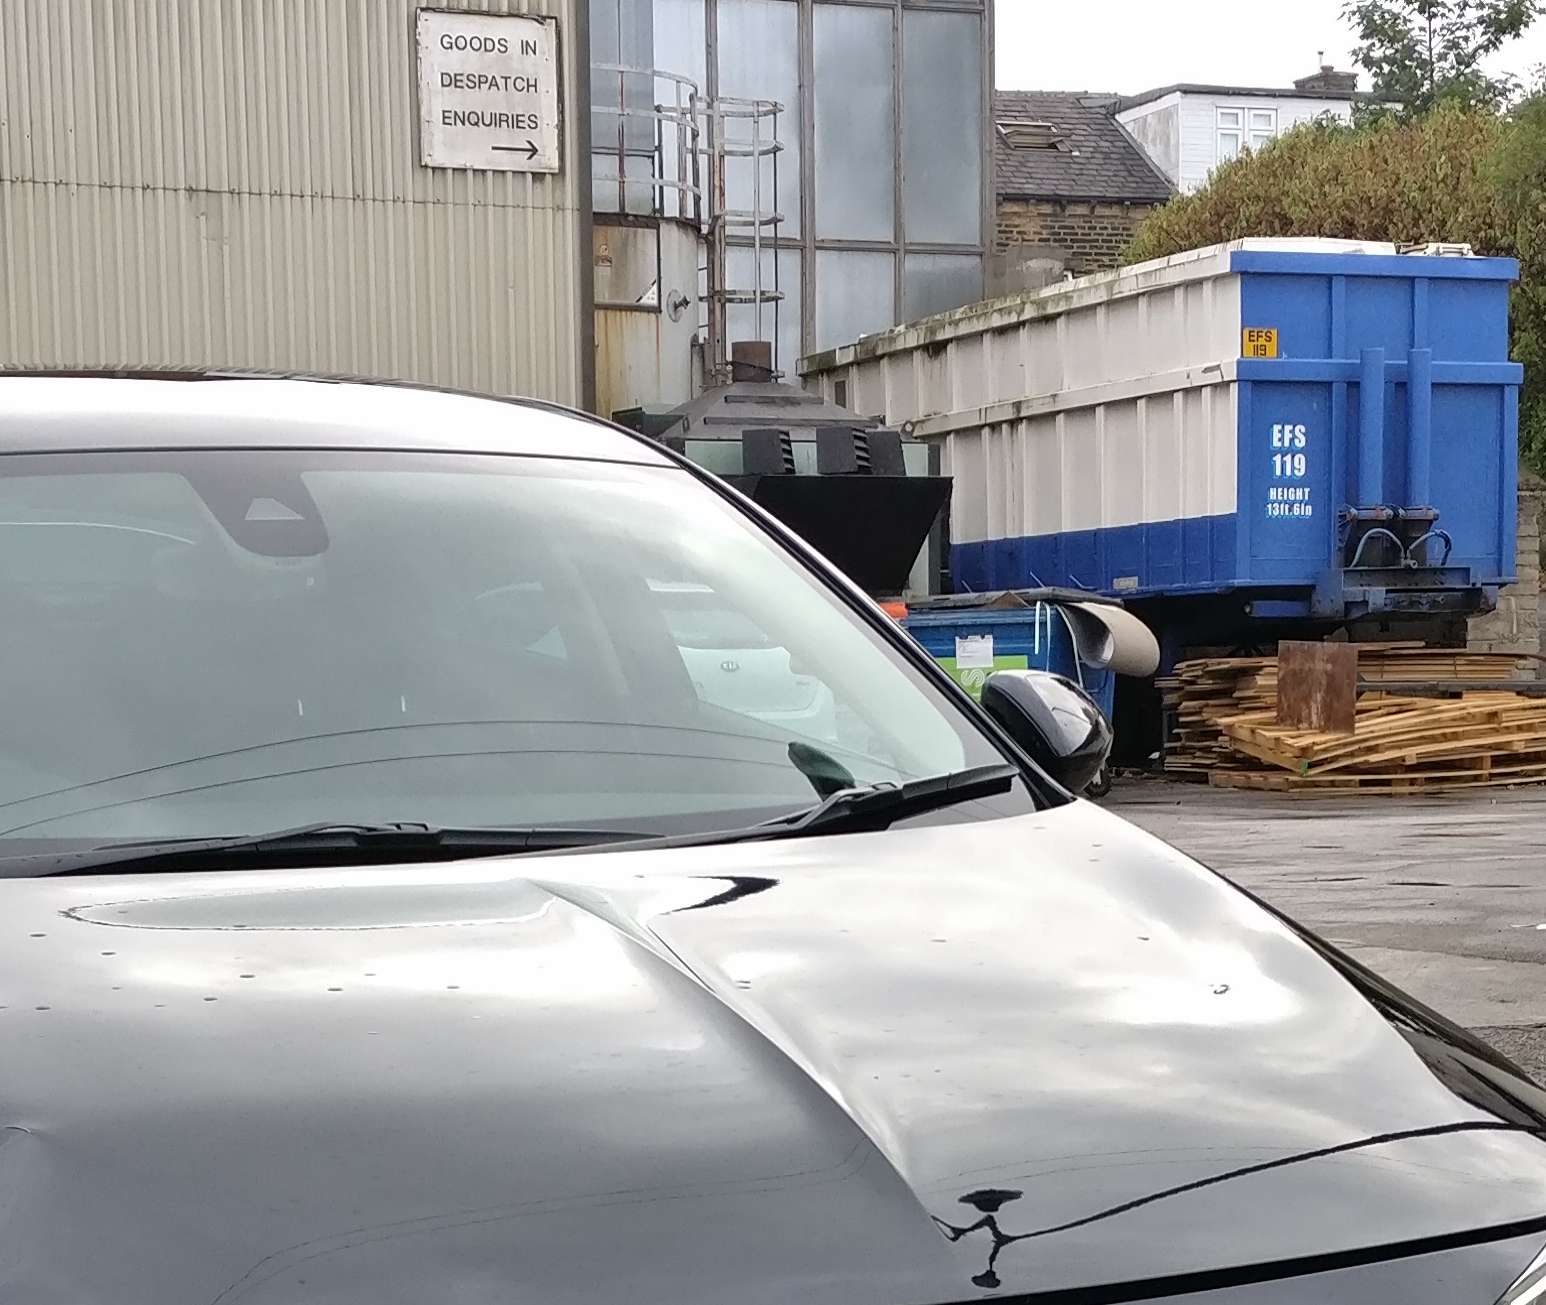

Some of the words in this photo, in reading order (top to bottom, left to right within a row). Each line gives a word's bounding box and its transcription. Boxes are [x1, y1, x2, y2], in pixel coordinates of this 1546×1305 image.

[440, 34, 508, 54] GOODS
[520, 39, 537, 56] IN
[440, 72, 538, 94] DESPATCH
[441, 110, 539, 130] ENQUIRIES
[1248, 329, 1273, 343] EFS
[1252, 344, 1267, 357] 119
[1271, 423, 1307, 449] EFS
[1272, 452, 1307, 477] 119
[1268, 487, 1311, 501] HEIGHT
